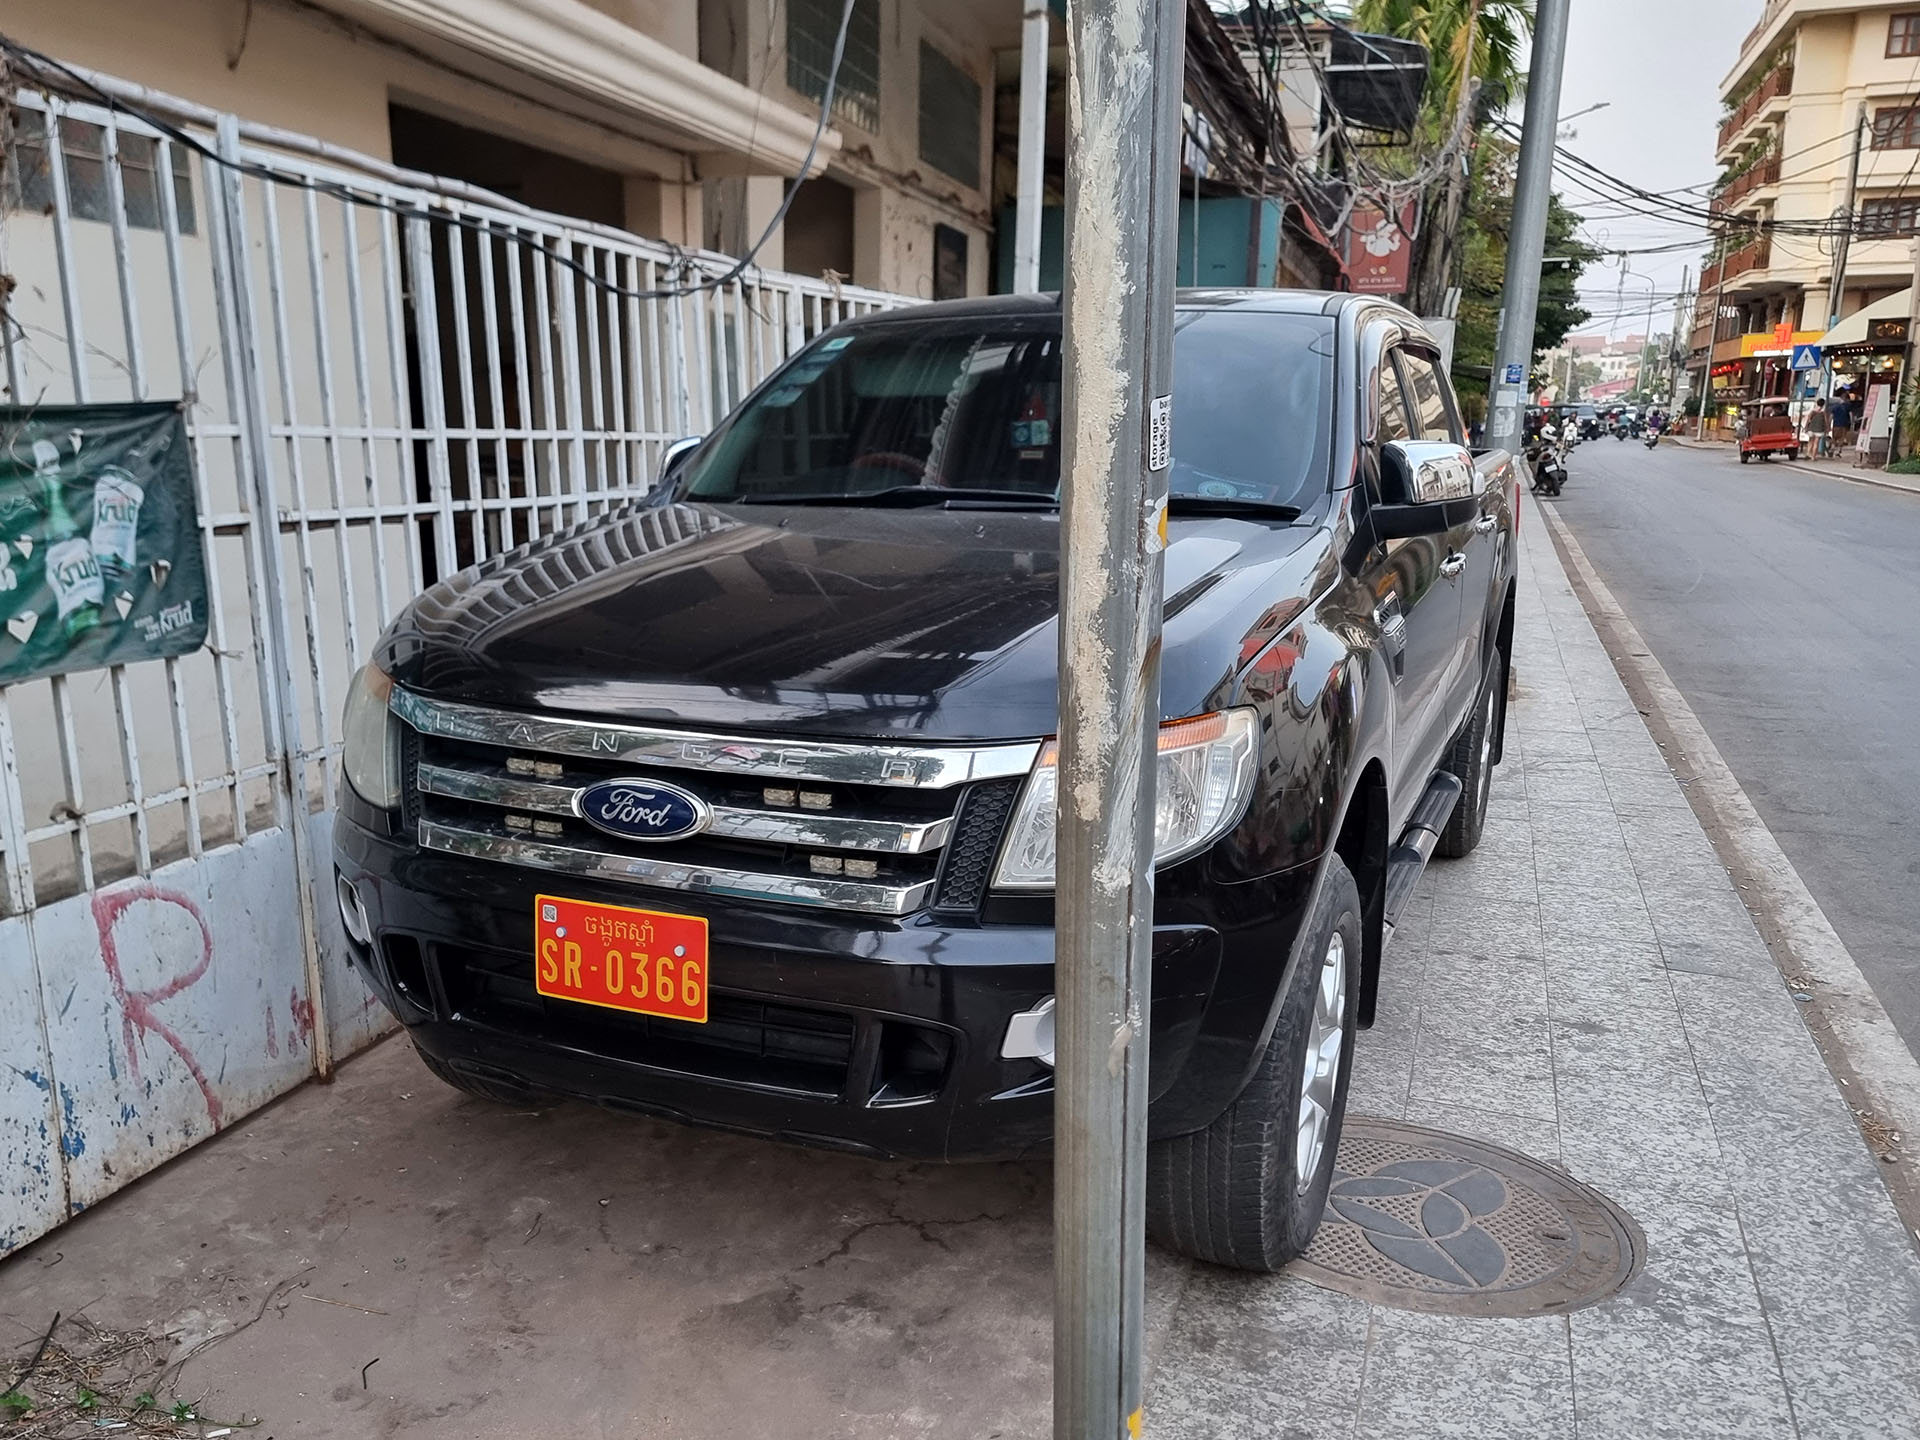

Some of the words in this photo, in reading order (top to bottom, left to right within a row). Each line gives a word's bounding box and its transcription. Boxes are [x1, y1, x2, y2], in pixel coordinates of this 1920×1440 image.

[159, 600, 193, 635] Krud
[601, 788, 672, 827] Ford
[542, 938, 700, 1007] SR-0366
[91, 885, 223, 1131] R
